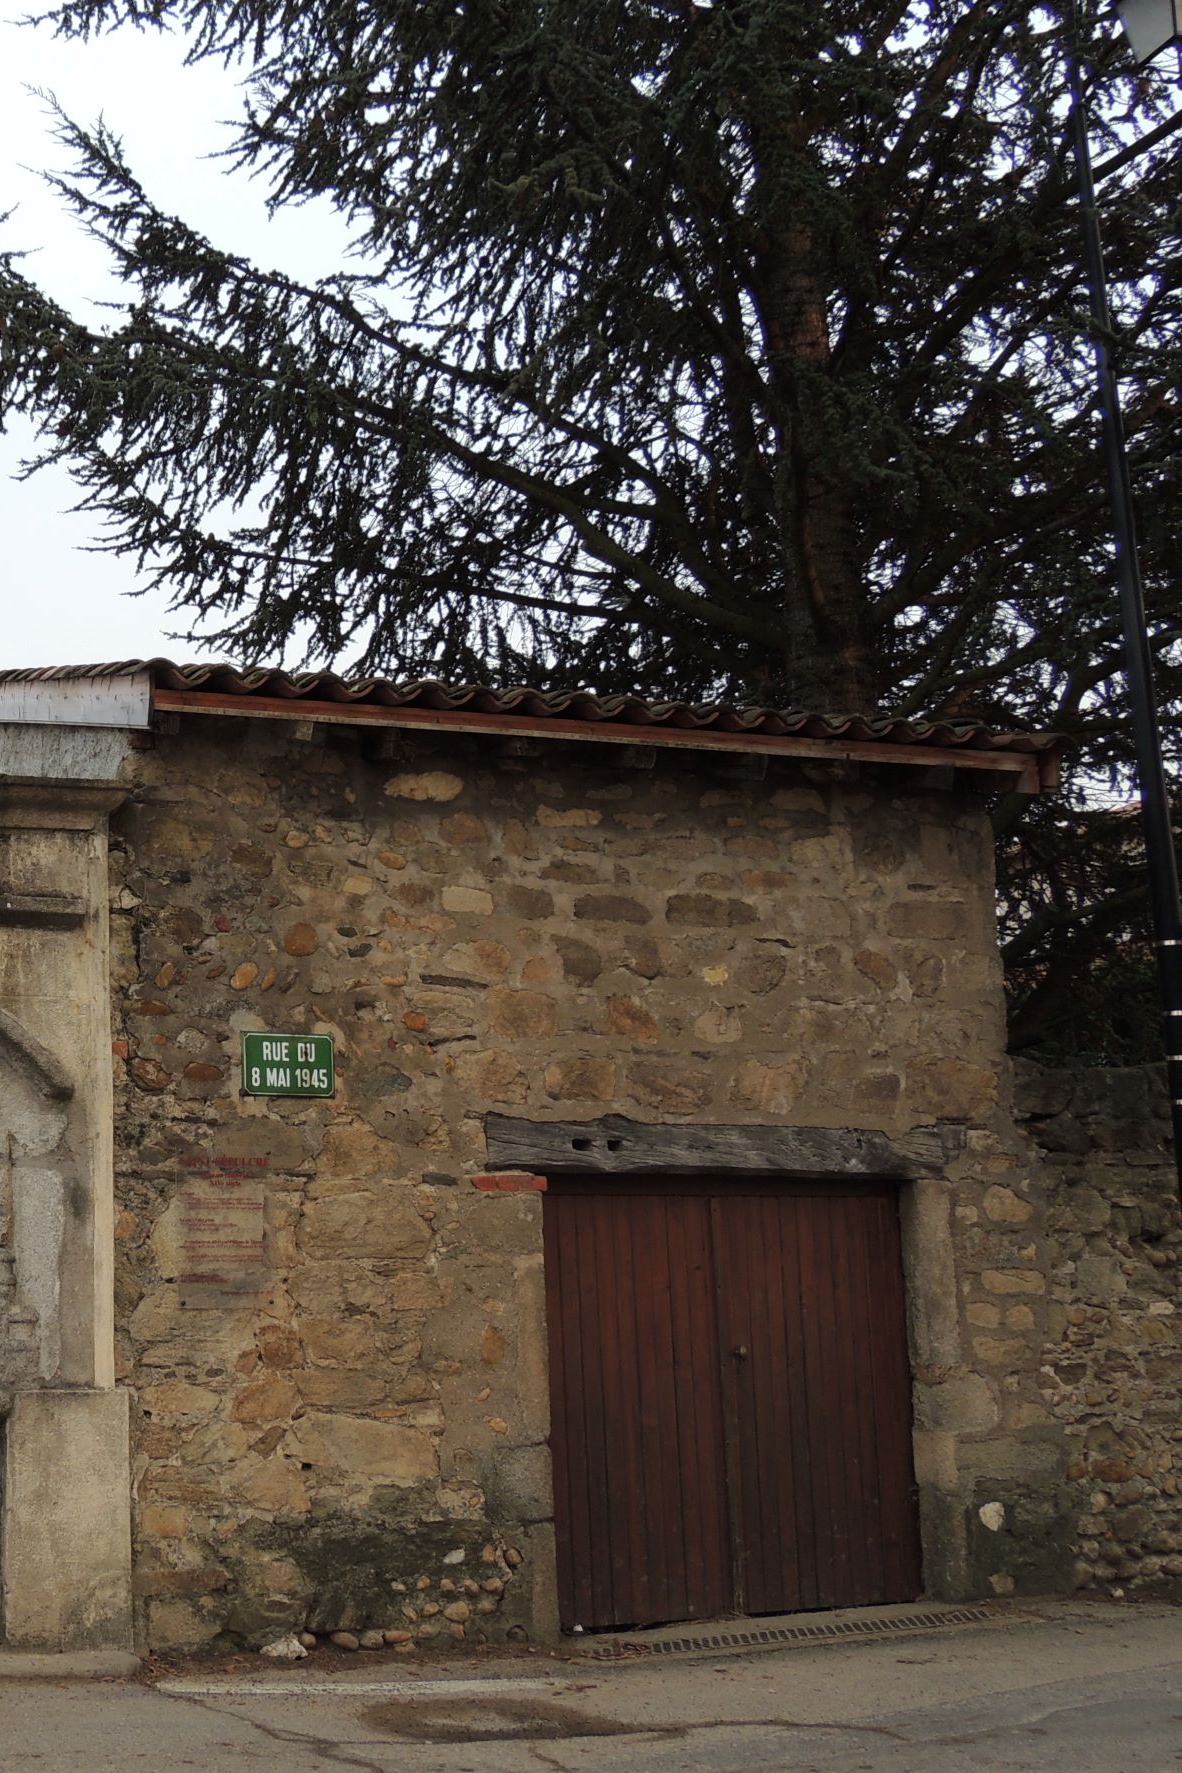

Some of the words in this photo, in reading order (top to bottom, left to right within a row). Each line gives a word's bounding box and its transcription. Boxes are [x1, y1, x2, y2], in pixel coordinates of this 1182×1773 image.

[262, 1041, 290, 1062] RUE
[297, 1042, 316, 1062] DU
[251, 1067, 260, 1087] 8
[266, 1067, 291, 1088] MAI
[295, 1068, 328, 1089] 1945
